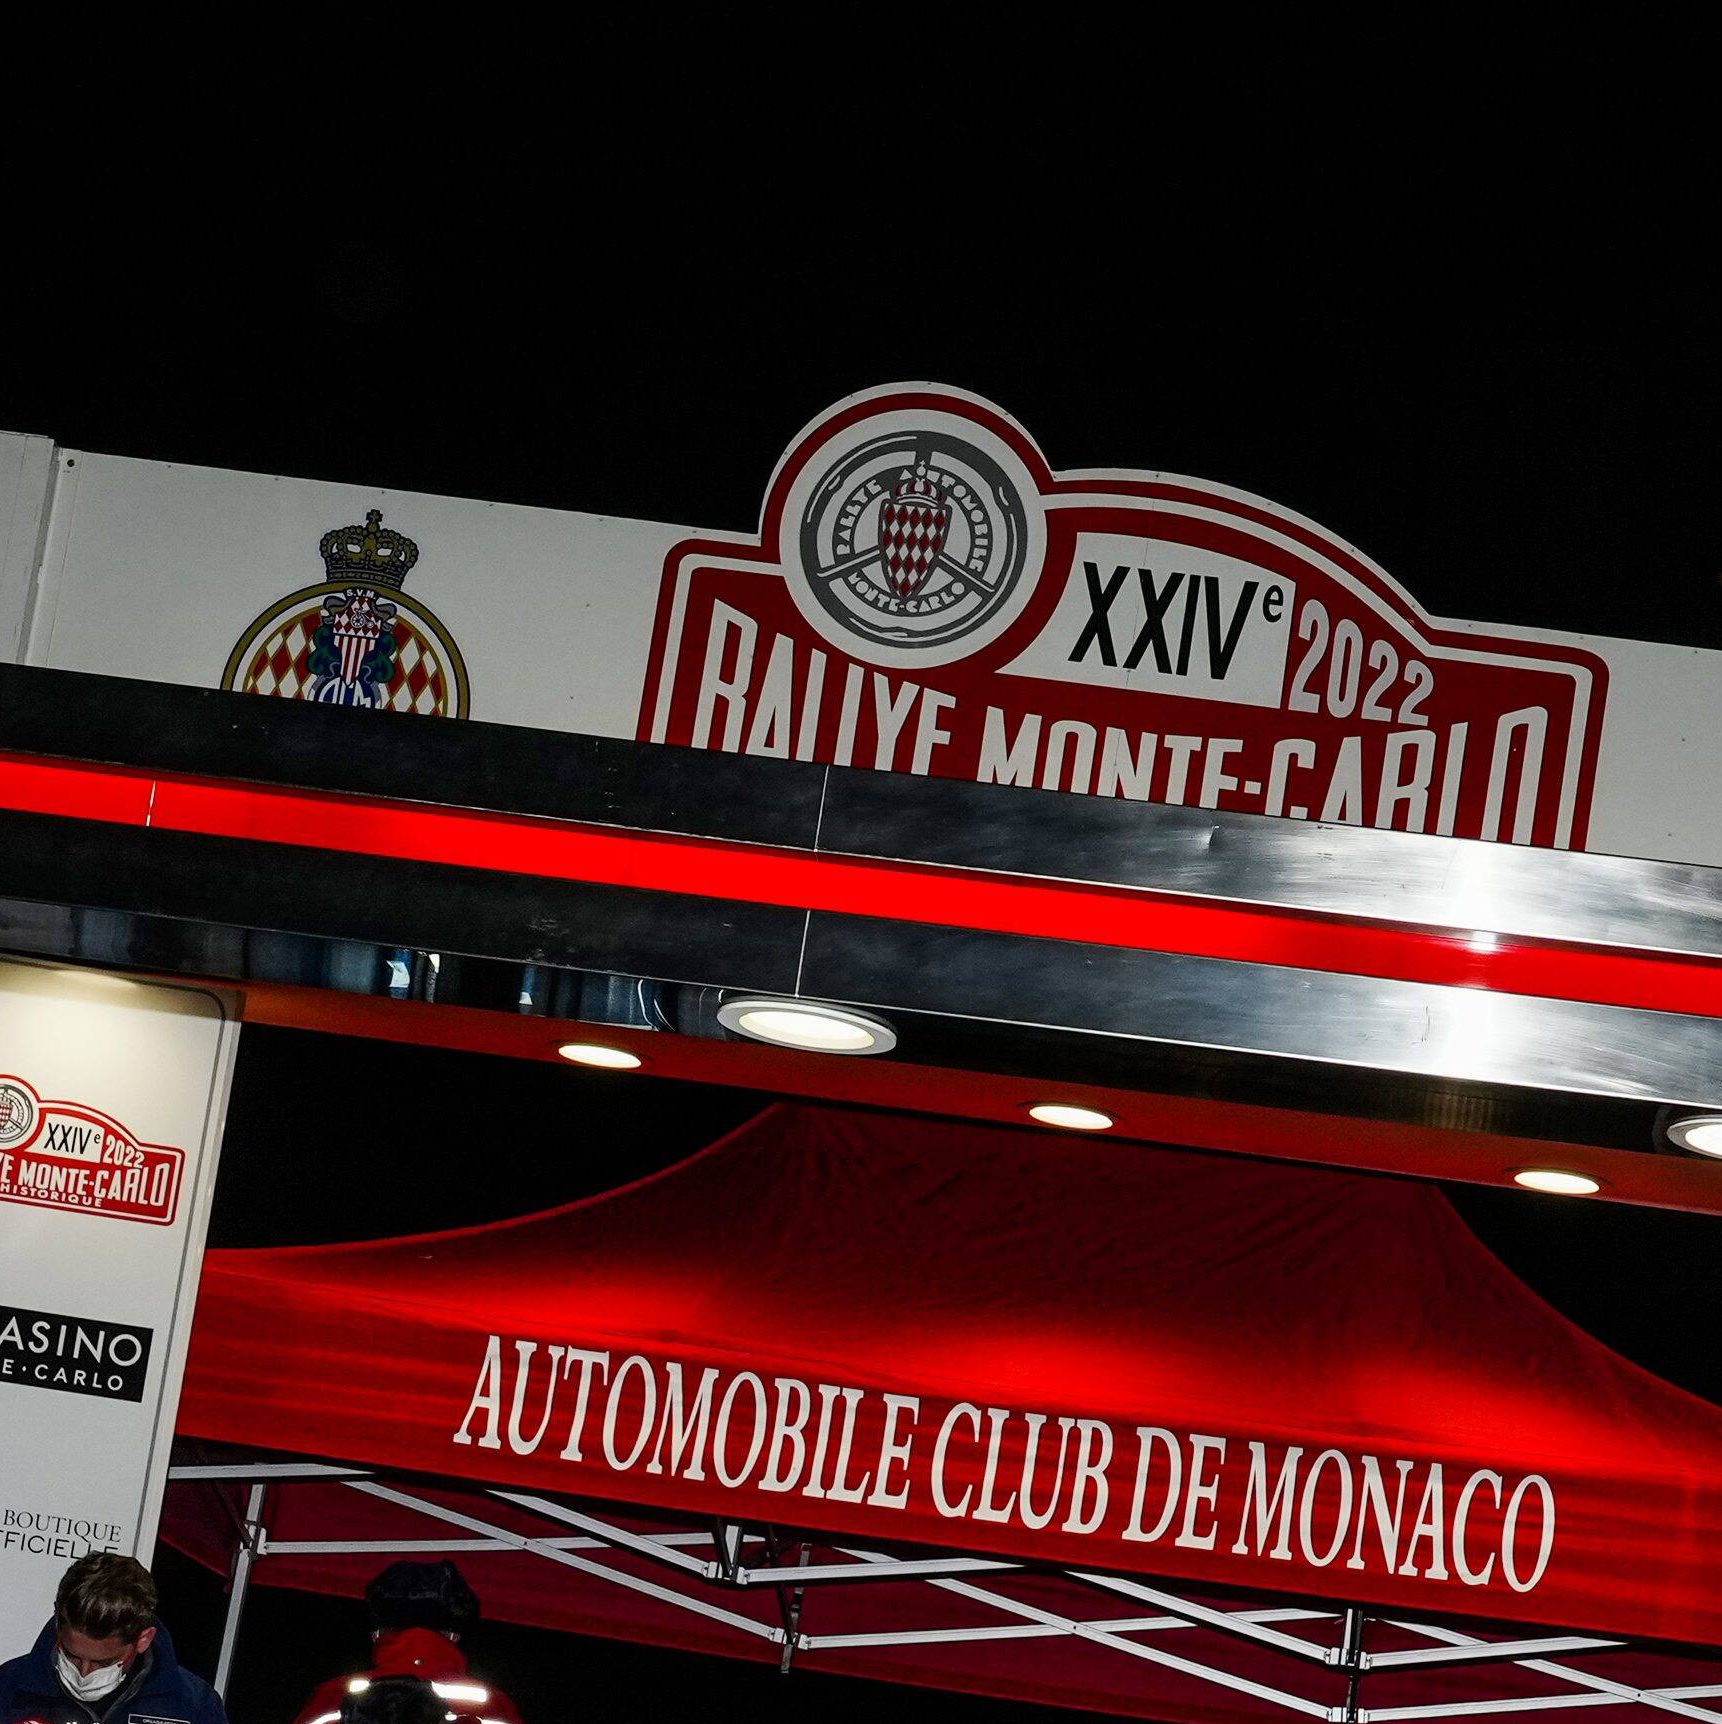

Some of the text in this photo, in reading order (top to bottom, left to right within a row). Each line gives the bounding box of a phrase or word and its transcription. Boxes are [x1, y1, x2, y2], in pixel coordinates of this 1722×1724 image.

[1288, 599, 1434, 726] 2022
[690, 598, 1548, 845] RALLYE MONTE-CARLO
[102, 1135, 145, 1169] 2022
[0, 1183, 102, 1208] HISTORIQUE
[17, 1159, 171, 1207] MONTE-CARLO
[452, 1335, 1555, 1594] AUTOMOBILE CLUB DE MONACO
[3, 1509, 122, 1544] BOUTIQUE
